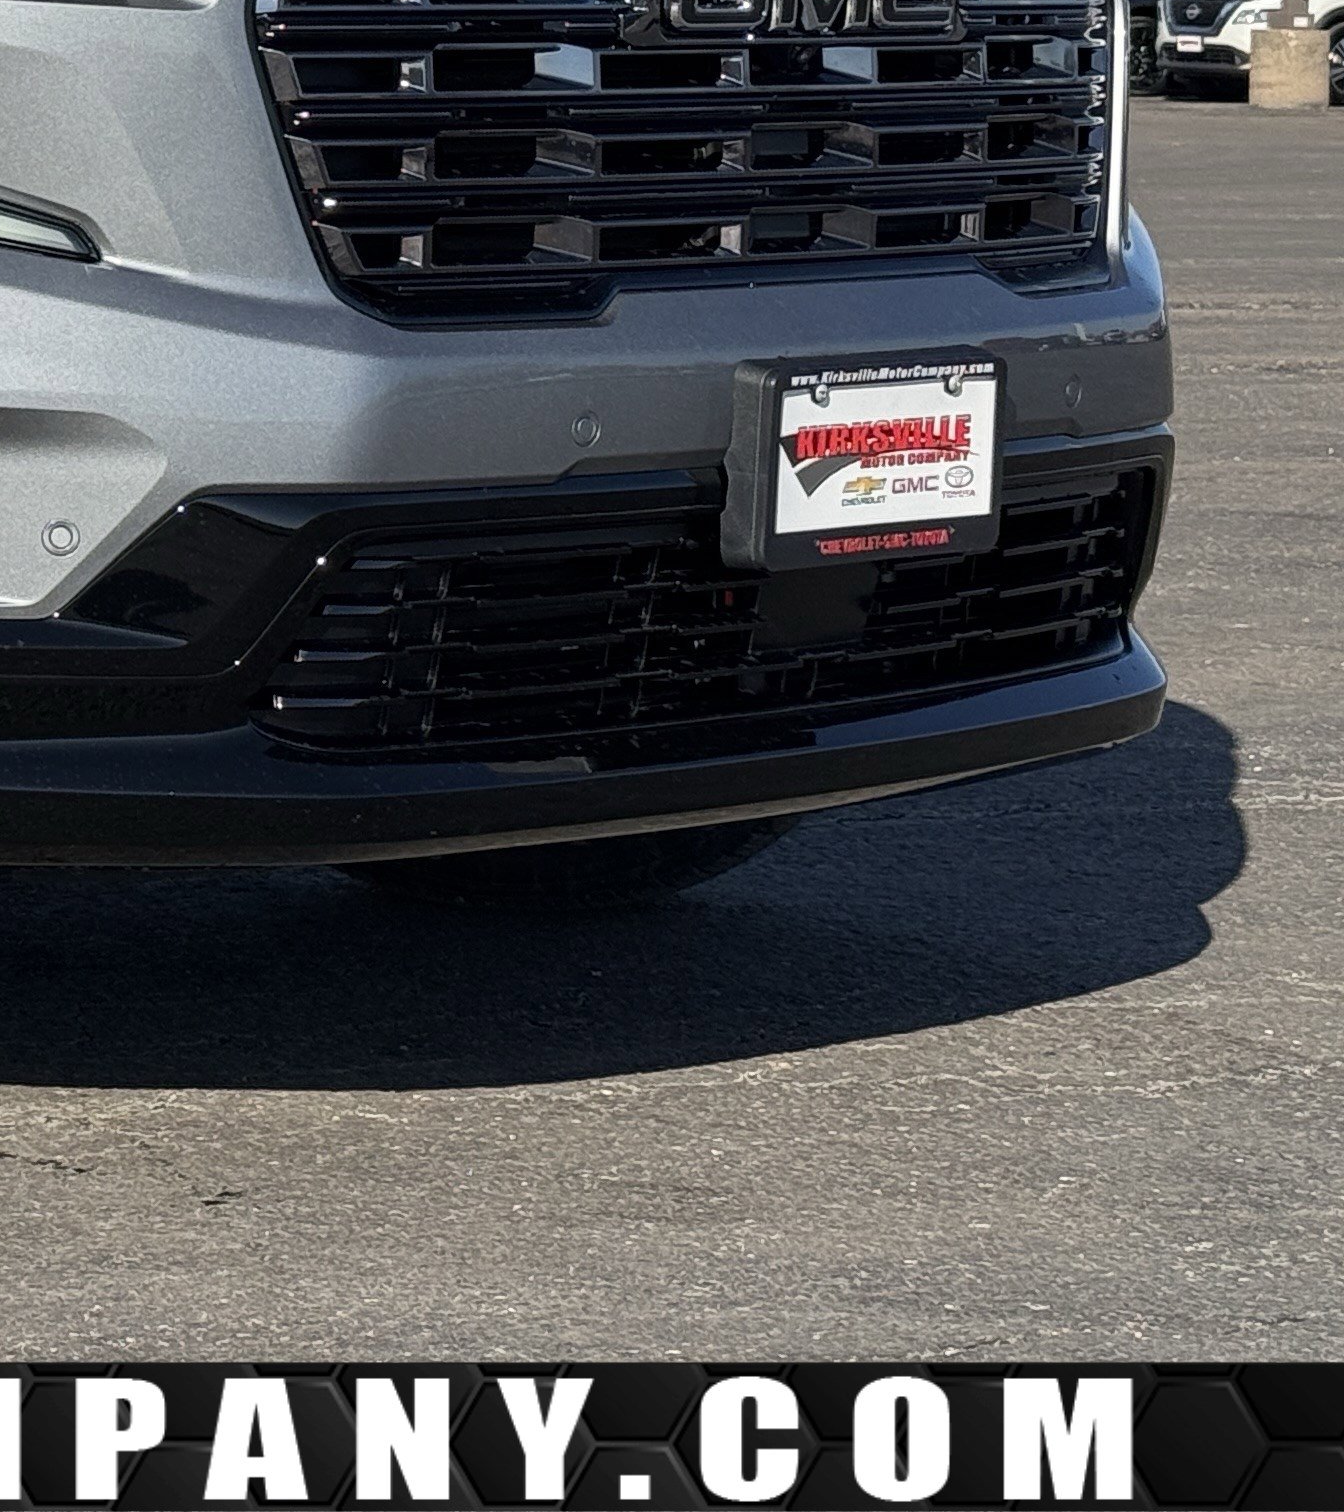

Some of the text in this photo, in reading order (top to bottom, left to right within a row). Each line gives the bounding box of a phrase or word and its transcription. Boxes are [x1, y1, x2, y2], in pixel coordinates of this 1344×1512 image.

[794, 414, 972, 461] KIRKSVILLE
[859, 450, 970, 469] MOTOR COMPANY
[891, 475, 940, 495] GMC
